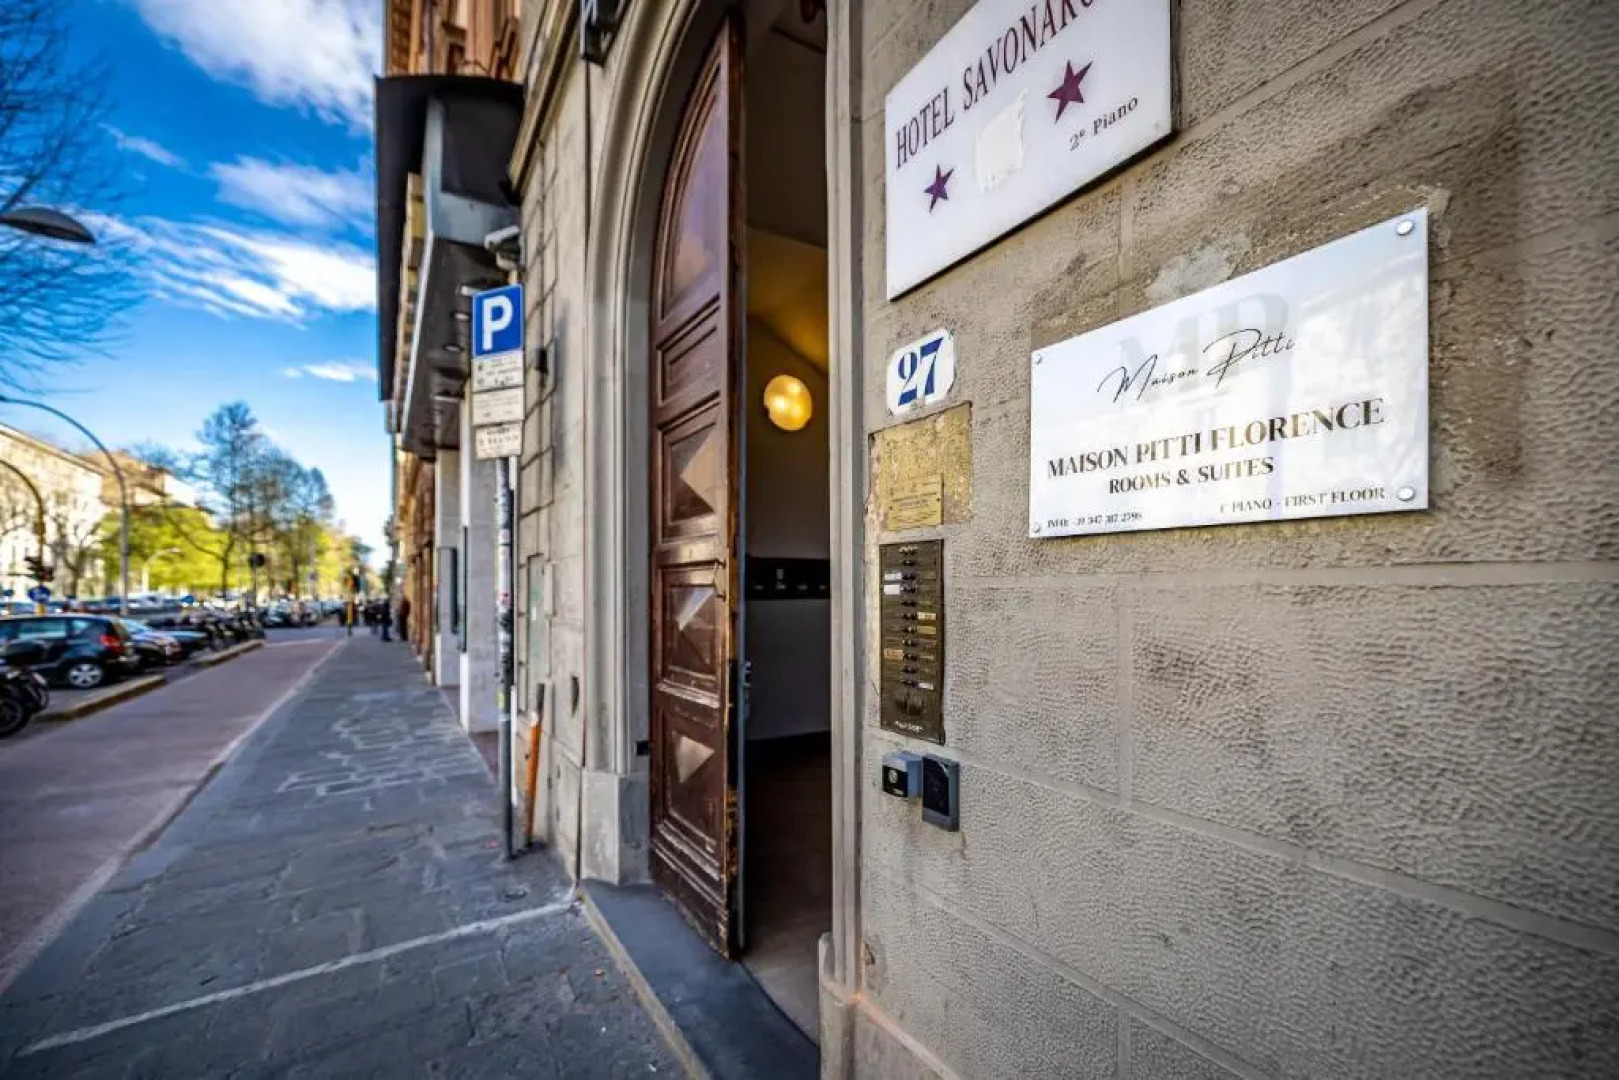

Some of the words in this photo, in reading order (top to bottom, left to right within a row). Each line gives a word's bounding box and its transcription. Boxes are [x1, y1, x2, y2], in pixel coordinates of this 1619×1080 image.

[895, 86, 955, 170] HOTEL
[963, 0, 1093, 111] SAVONAR
[1092, 97, 1139, 136] Piano
[481, 295, 514, 351] P
[897, 336, 945, 407] 27
[1097, 353, 1199, 403] Maison
[1202, 328, 1296, 389] Pitti
[1048, 444, 1129, 479] MAISON
[1135, 431, 1202, 465] PITTI
[1210, 396, 1385, 452] FLORENCE
[1108, 471, 1171, 494] ROOMS
[1175, 467, 1190, 485] &
[1197, 455, 1275, 484] SUITES
[1232, 498, 1272, 513] PIANO
[1284, 492, 1327, 507] FIRST
[1331, 486, 1385, 504] FLOOR
